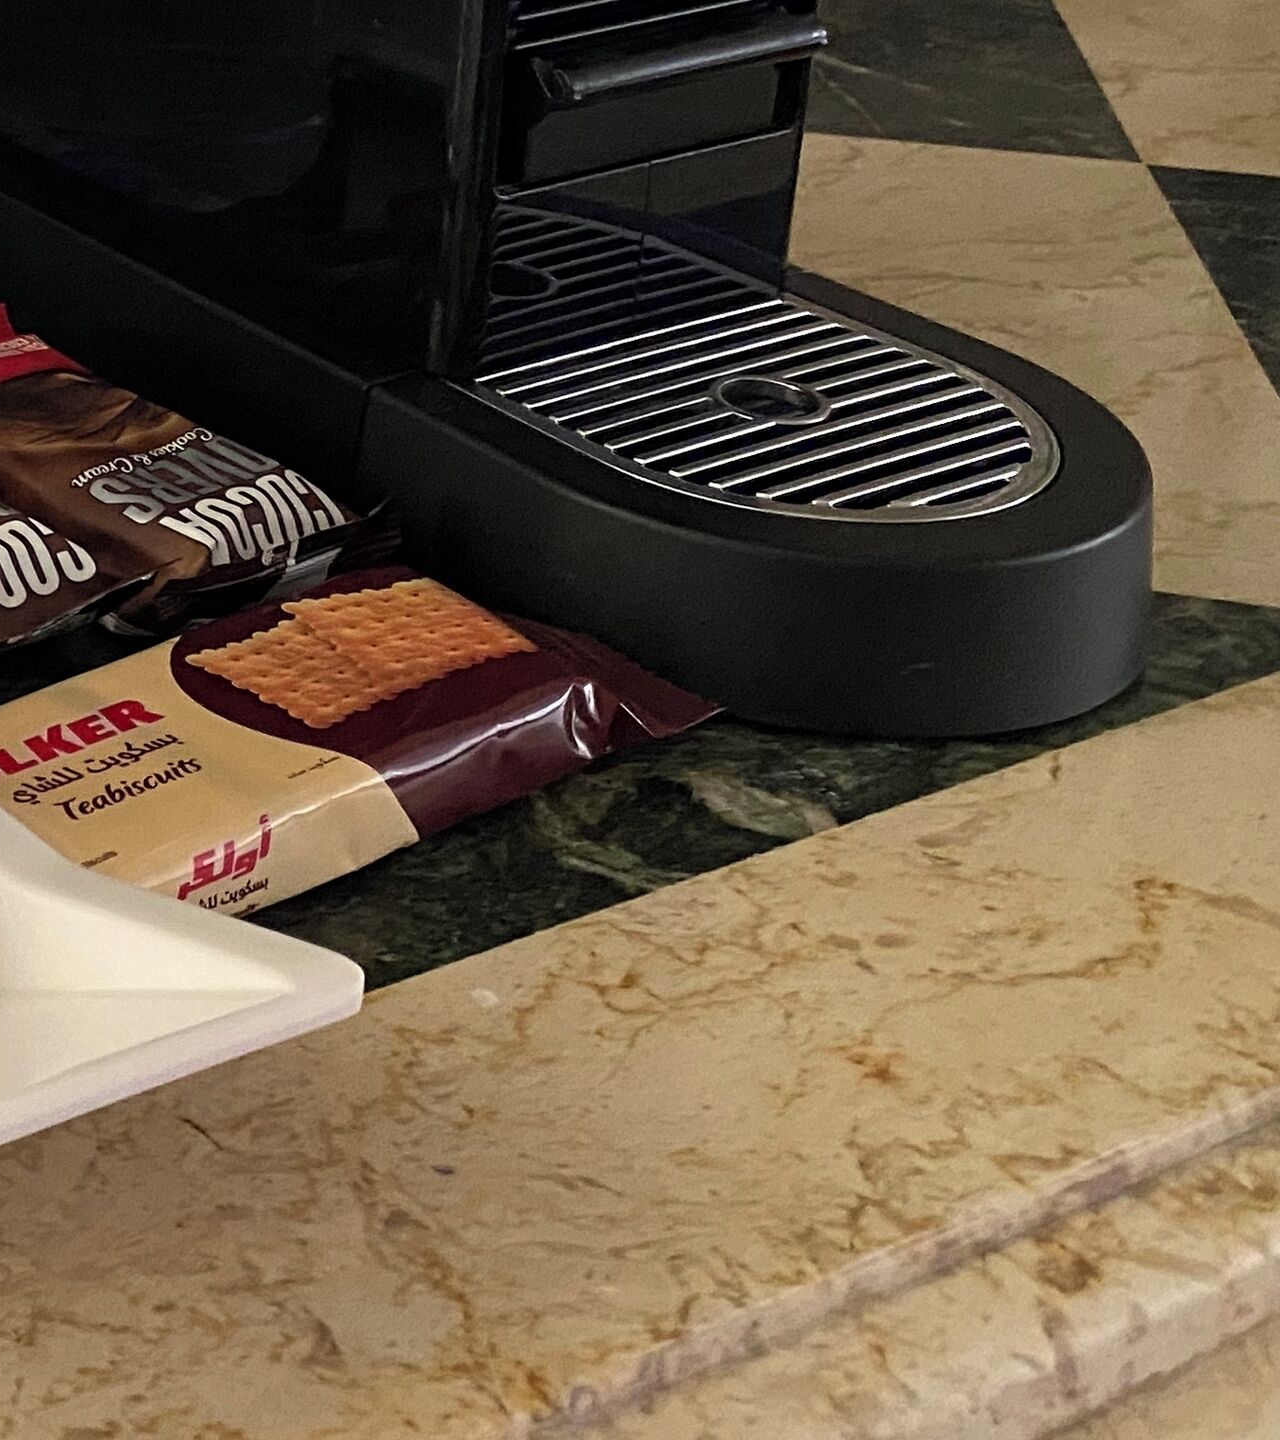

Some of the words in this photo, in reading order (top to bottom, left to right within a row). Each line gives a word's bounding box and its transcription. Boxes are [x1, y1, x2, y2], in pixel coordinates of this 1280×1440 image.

[132, 453, 152, 466] &
[148, 426, 213, 458] Cookies
[71, 456, 135, 489] Cream
[83, 733, 185, 774] بسكويت
[12, 766, 85, 806] للشاي
[53, 758, 202, 821] Teabiscuits
[176, 813, 273, 902] أولكر
[220, 877, 269, 906] بسكويت
